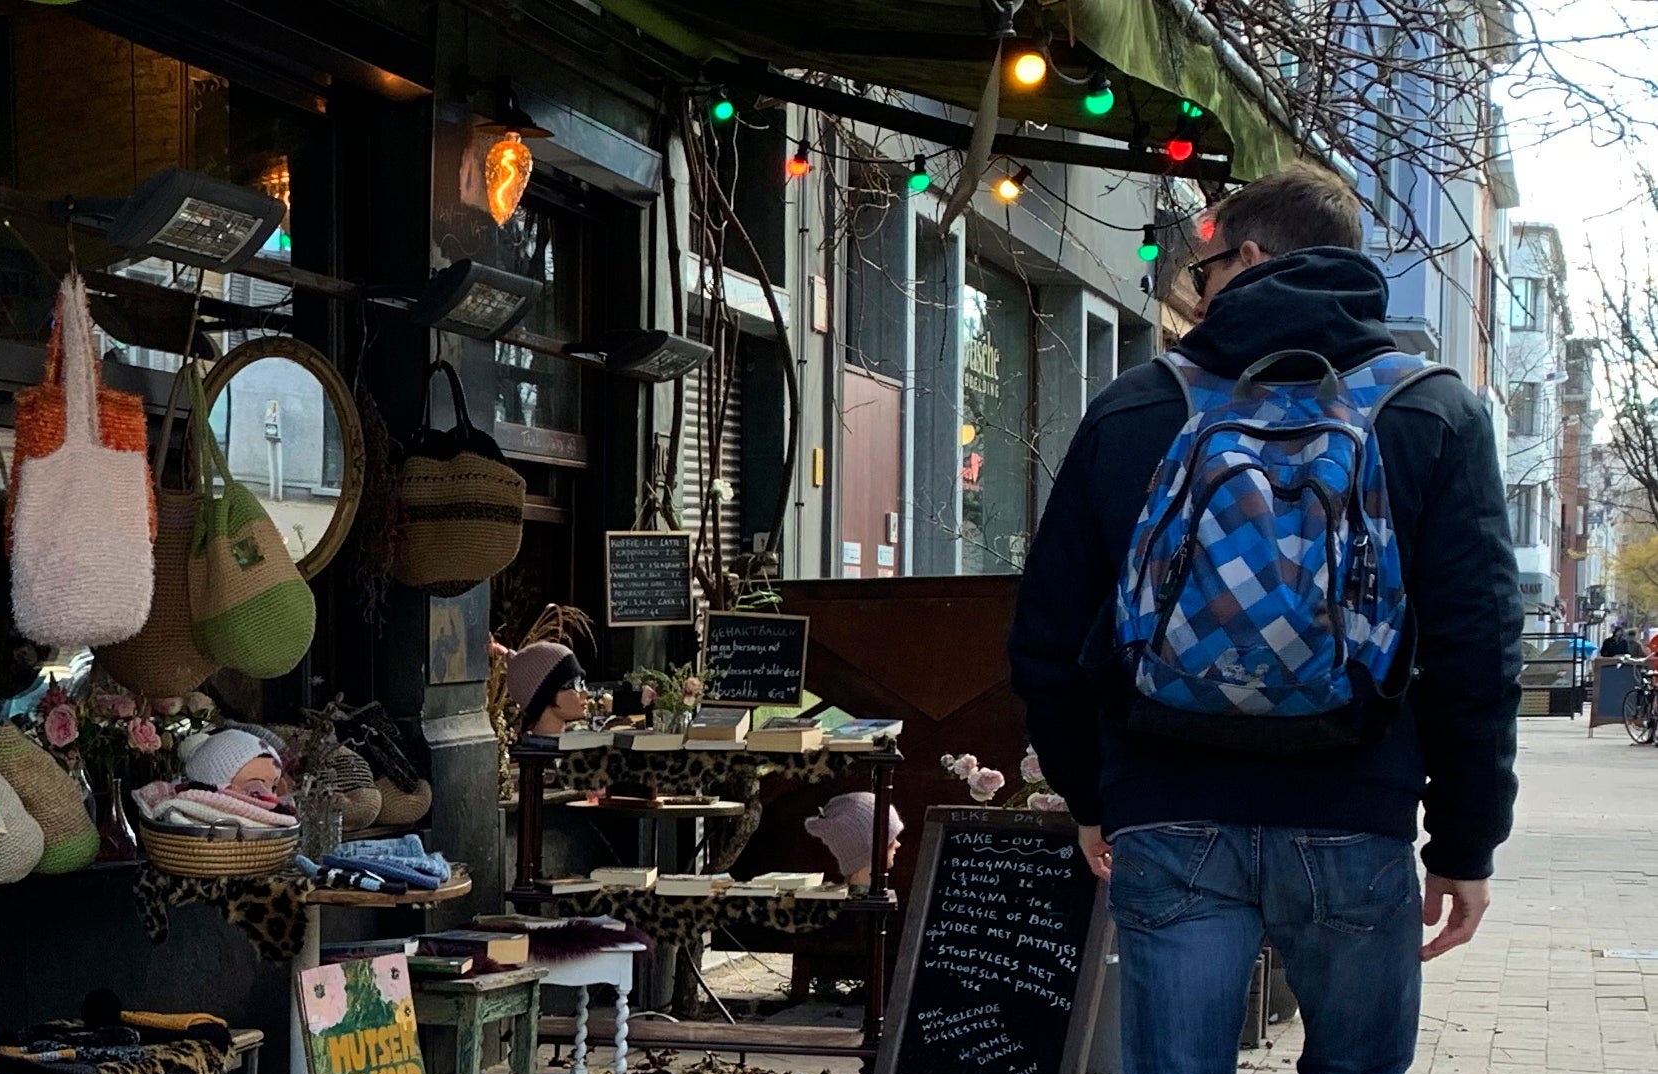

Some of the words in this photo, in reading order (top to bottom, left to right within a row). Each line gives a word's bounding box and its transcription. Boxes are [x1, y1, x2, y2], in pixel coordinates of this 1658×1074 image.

[951, 811, 990, 822] ELKE
[951, 833, 992, 844] TAKE
[1007, 912, 1022, 921] OF
[1029, 913, 1064, 930] BOLO
[987, 928, 1011, 939] MET
[1016, 934, 1077, 958] PATATJES
[1028, 963, 1056, 983] MET
[1014, 980, 1072, 1012] PATATJES
[918, 1007, 943, 1020] OOK
[958, 1033, 1010, 1061] WARME
[977, 1041, 1024, 1065] DRANK
